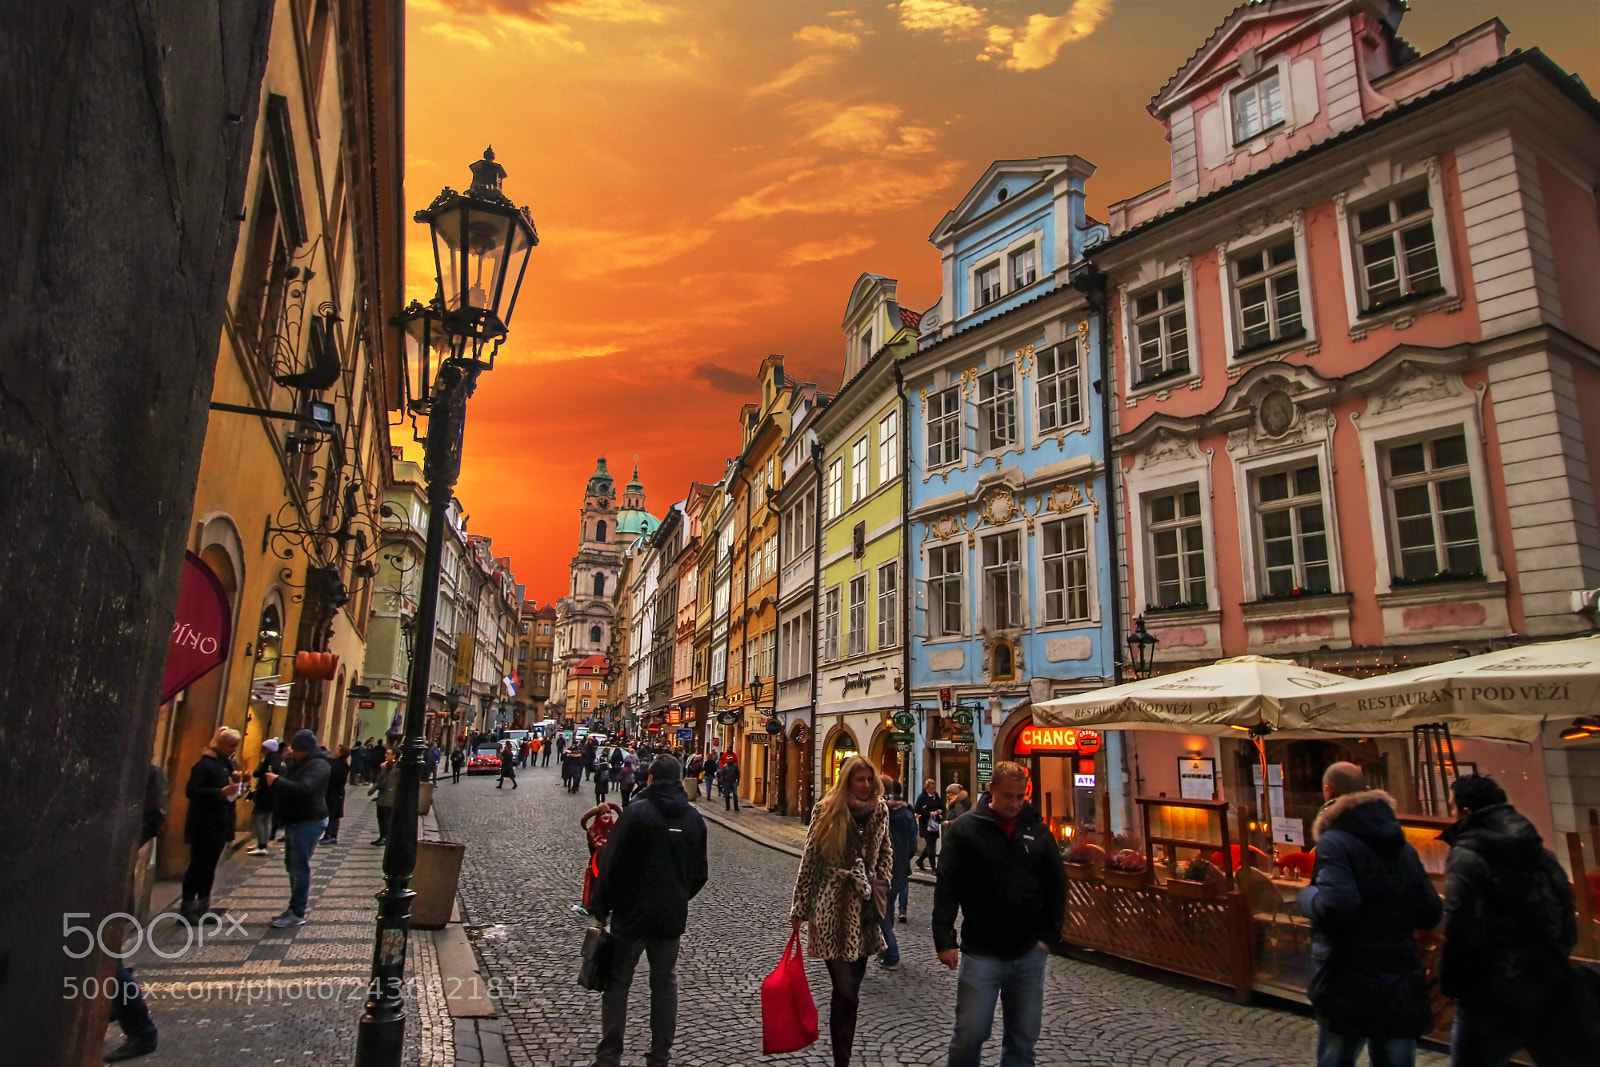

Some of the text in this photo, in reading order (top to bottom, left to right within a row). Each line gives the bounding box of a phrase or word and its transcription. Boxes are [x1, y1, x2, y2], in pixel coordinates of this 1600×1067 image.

[1358, 682, 1571, 711] RESTAURANT POD VĚŽÍ
[1074, 701, 1137, 718] RESTAURANT
[1138, 702, 1164, 714] POD
[1166, 701, 1193, 715] VĚŽÍ
[750, 733, 771, 741] CHANGE
[1022, 730, 1079, 746] CHANG
[1079, 729, 1098, 738] change
